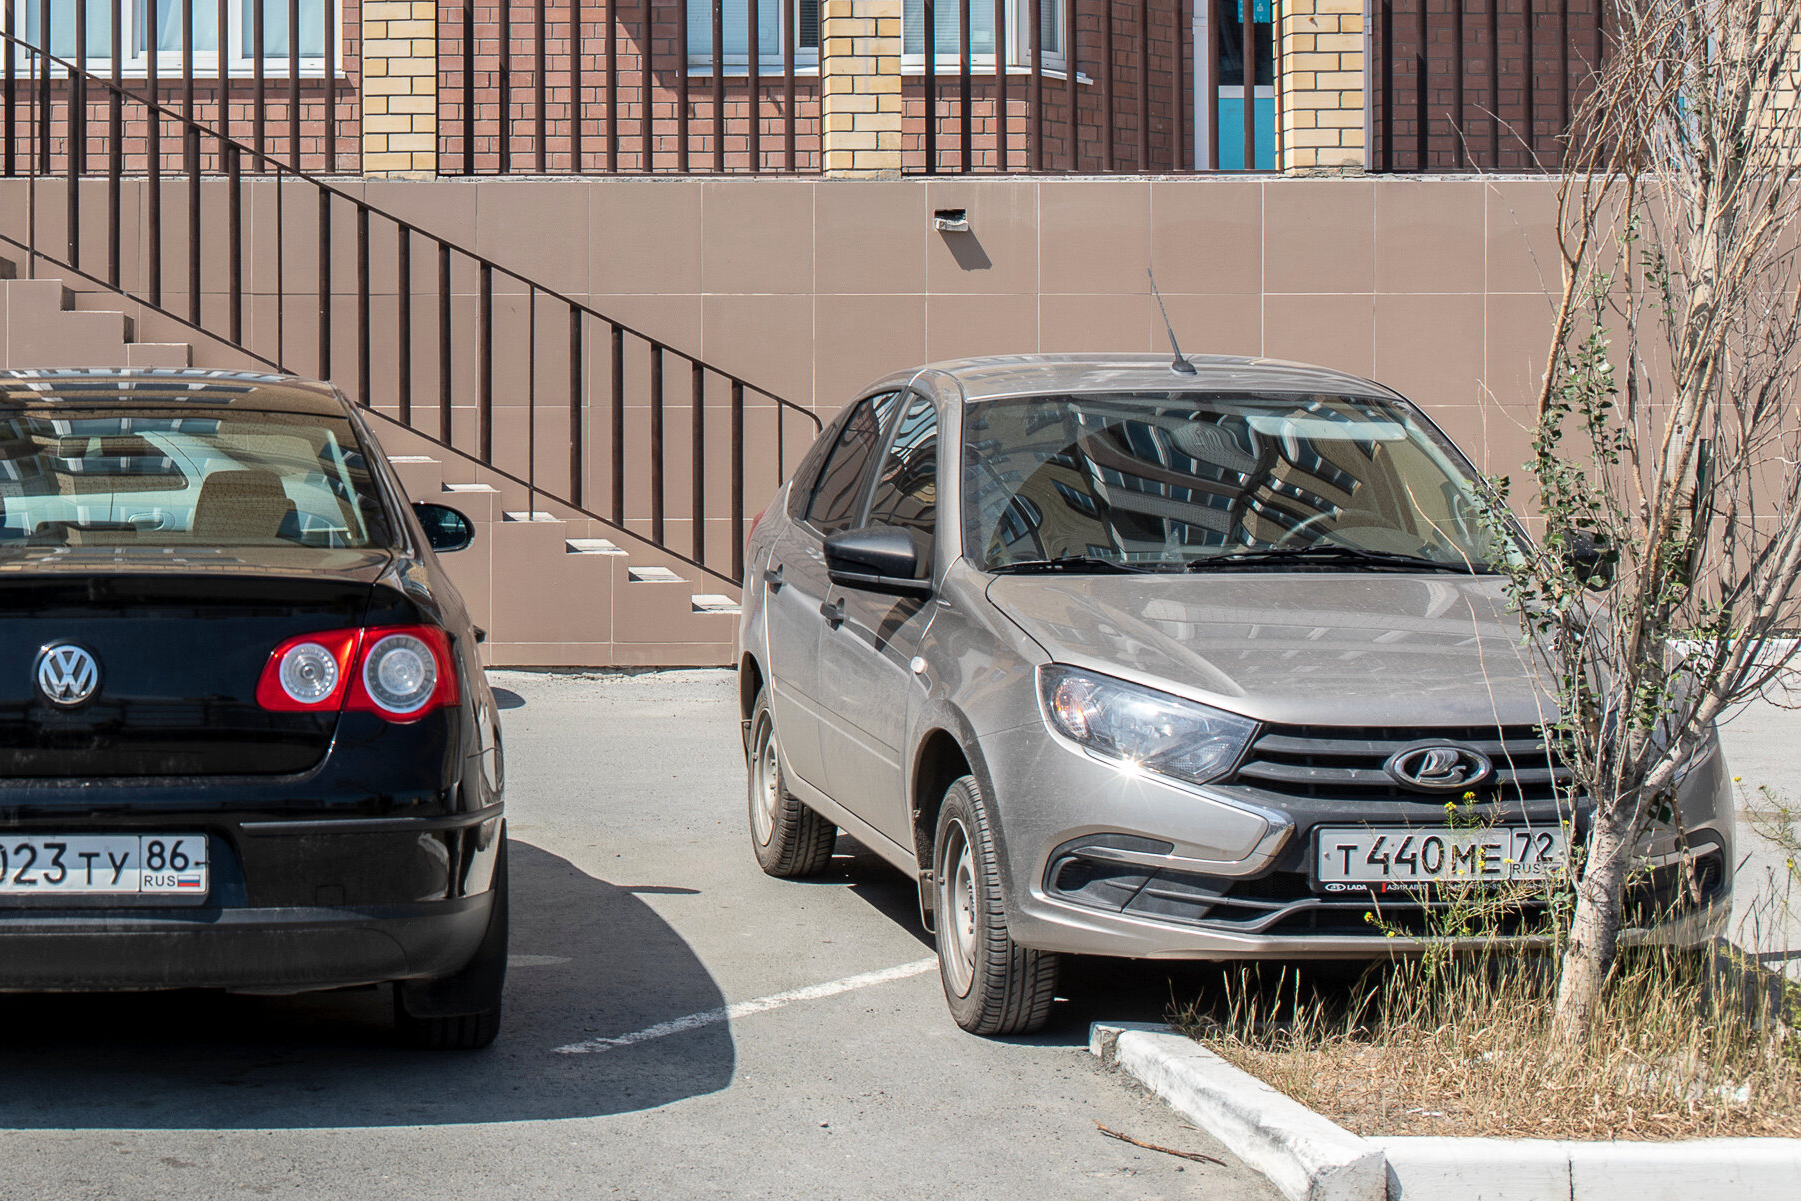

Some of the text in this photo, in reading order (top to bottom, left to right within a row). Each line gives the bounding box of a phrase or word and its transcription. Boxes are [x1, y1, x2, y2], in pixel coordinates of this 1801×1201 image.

[146, 838, 189, 872] 86
[1515, 832, 1554, 863] 72
[1512, 863, 1540, 875] RUS
[143, 875, 177, 888] RUS
